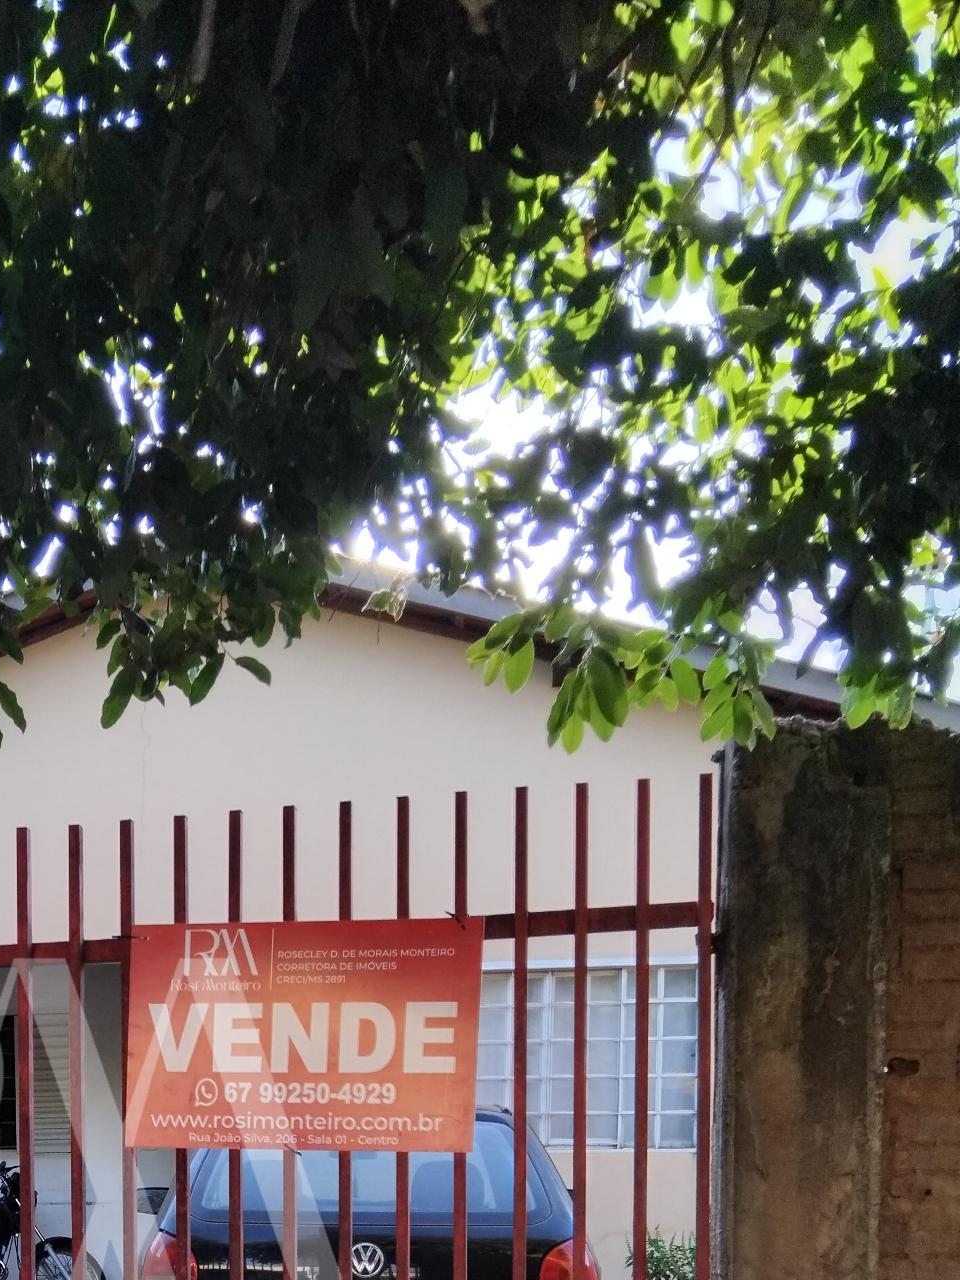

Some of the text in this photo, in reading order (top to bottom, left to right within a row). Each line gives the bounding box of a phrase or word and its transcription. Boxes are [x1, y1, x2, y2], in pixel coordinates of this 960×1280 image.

[277, 948, 455, 959] ROSECLEY D. DE MORAIS MONTEIRO
[277, 960, 397, 972] CORRETORA DE IMÓVEIS
[201, 977, 261, 992] Monteiro
[276, 975, 324, 985] CRECI/MS
[148, 1001, 458, 1073] VENDE
[224, 1082, 397, 1105] 67 99250-4929
[150, 1111, 444, 1133] www.rosimonteiro.com.br
[189, 1132, 210, 1143] Rua
[214, 1133, 240, 1144] João
[244, 1134, 273, 1146] Silva,
[276, 1135, 297, 1145] 206
[308, 1135, 332, 1145] Sala
[336, 1135, 347, 1145] 01
[358, 1135, 399, 1146] Centro
